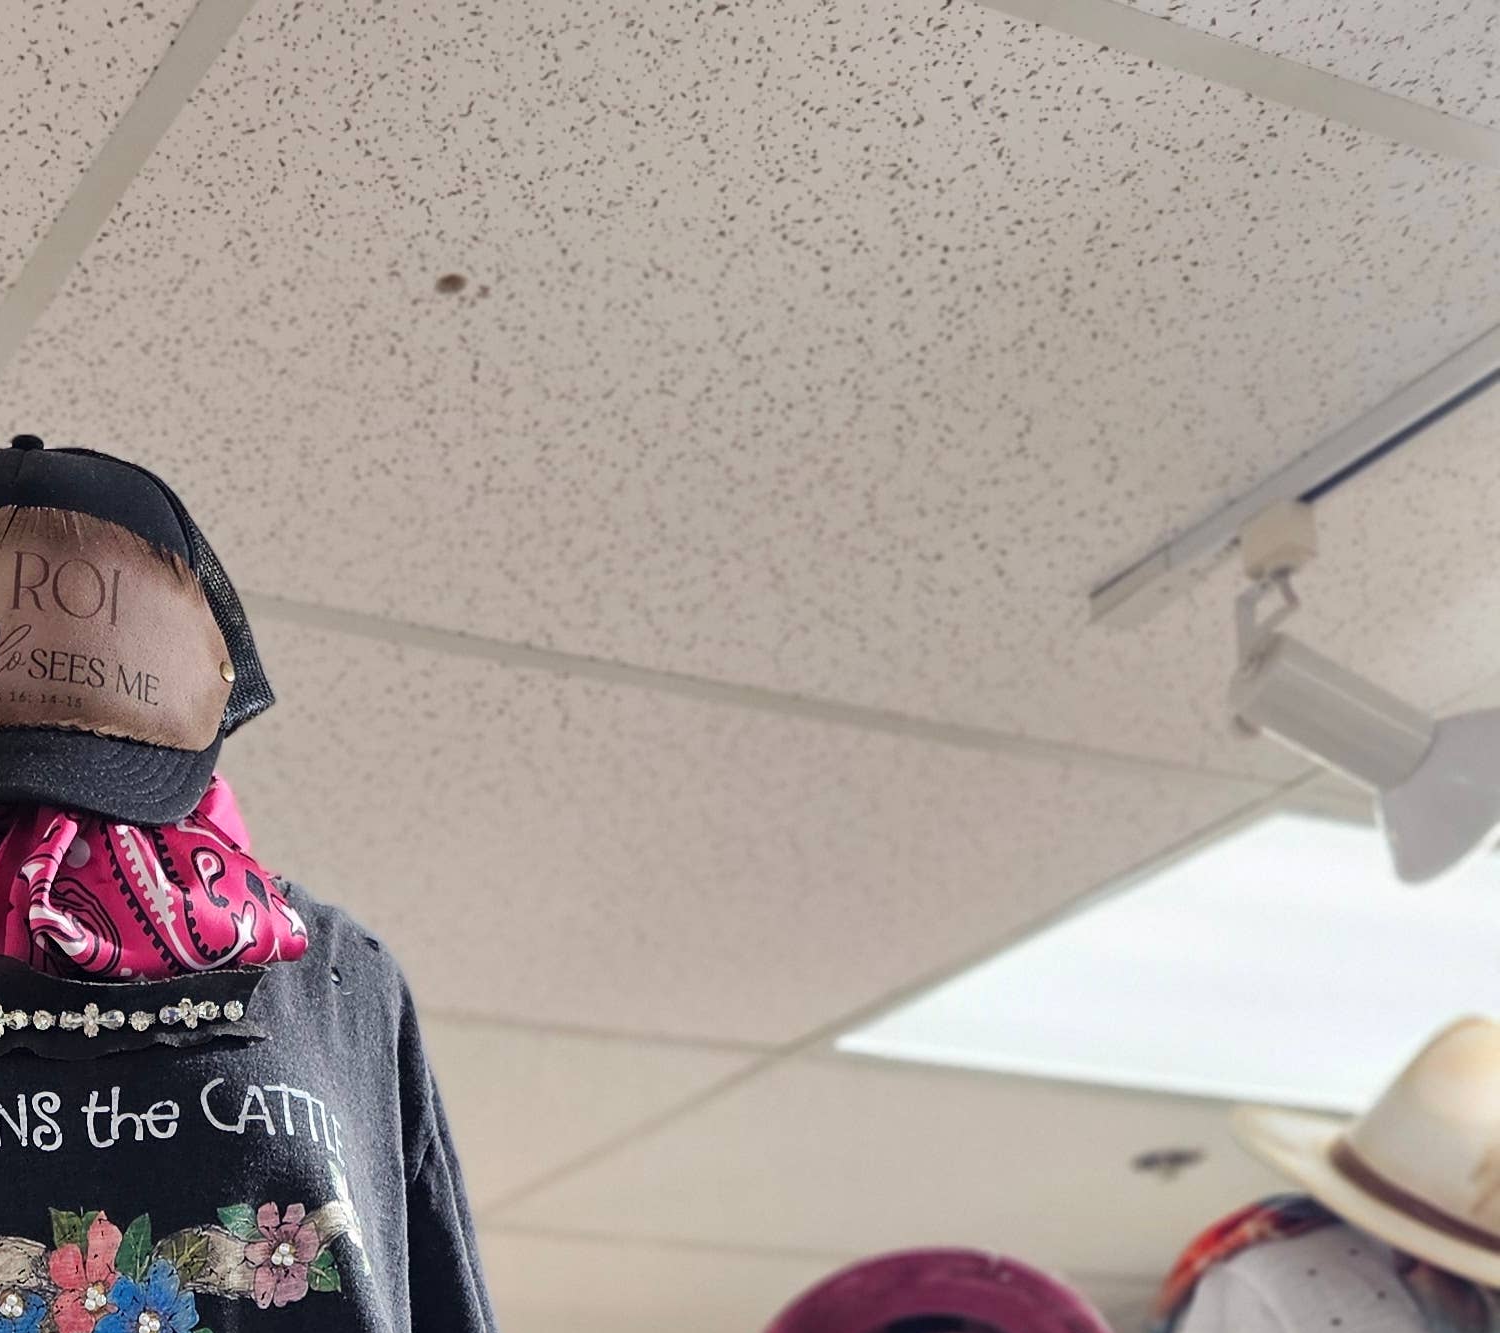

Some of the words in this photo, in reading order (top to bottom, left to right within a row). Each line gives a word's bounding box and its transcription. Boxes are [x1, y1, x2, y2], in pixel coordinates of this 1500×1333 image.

[10, 550, 121, 627] ROI
[28, 648, 106, 689] SEES
[115, 664, 161, 706] ME
[80, 1085, 181, 1149] the
[200, 1077, 348, 1168] CATTLE
